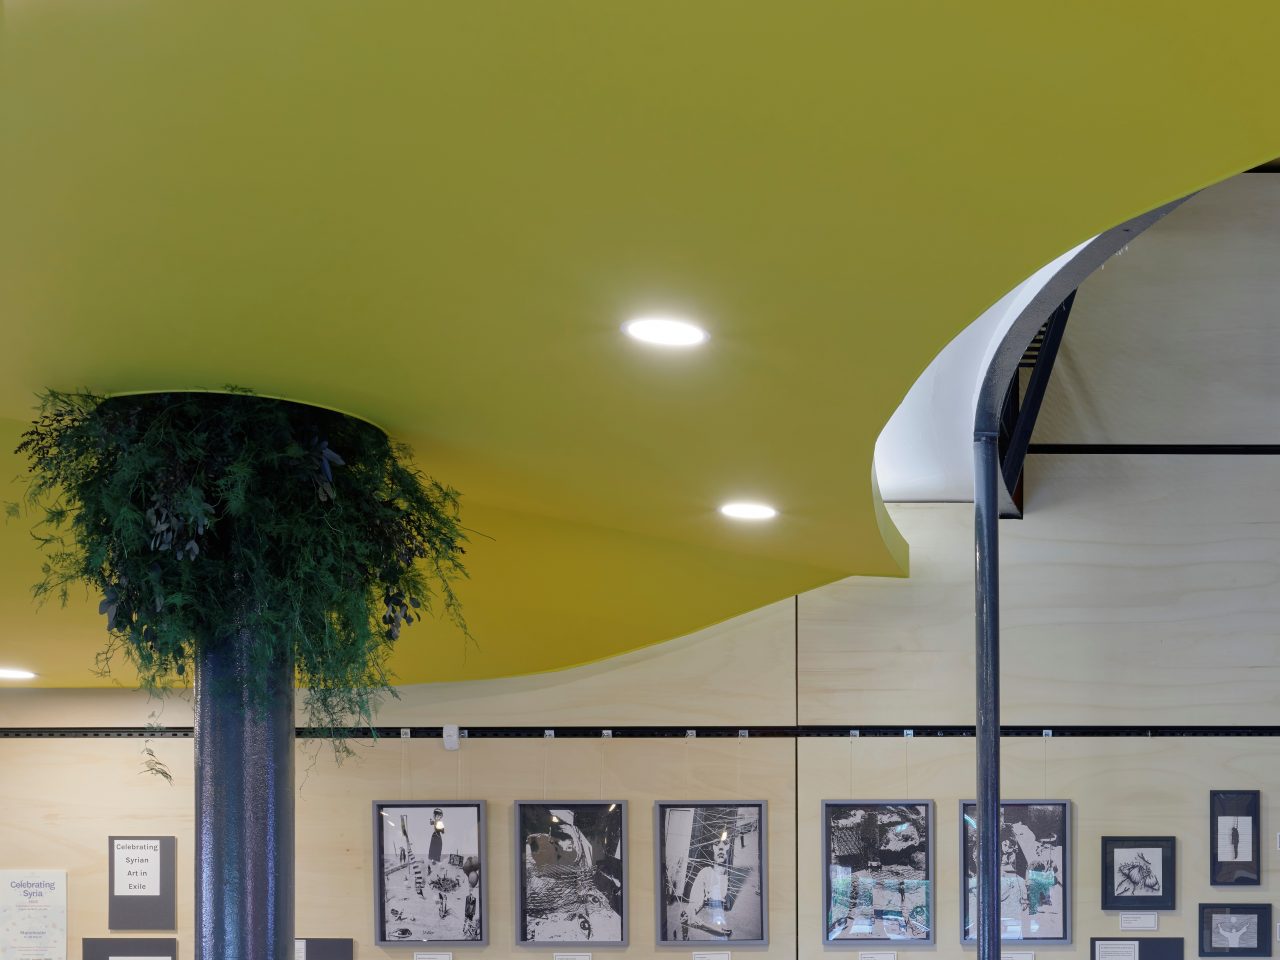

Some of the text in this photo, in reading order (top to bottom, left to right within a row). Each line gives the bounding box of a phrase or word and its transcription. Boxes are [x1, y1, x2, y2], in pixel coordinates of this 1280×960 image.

[116, 843, 159, 852] Celebrating
[125, 856, 149, 865] Syrian
[10, 881, 56, 891] Celebrating
[23, 889, 43, 899] Syria
